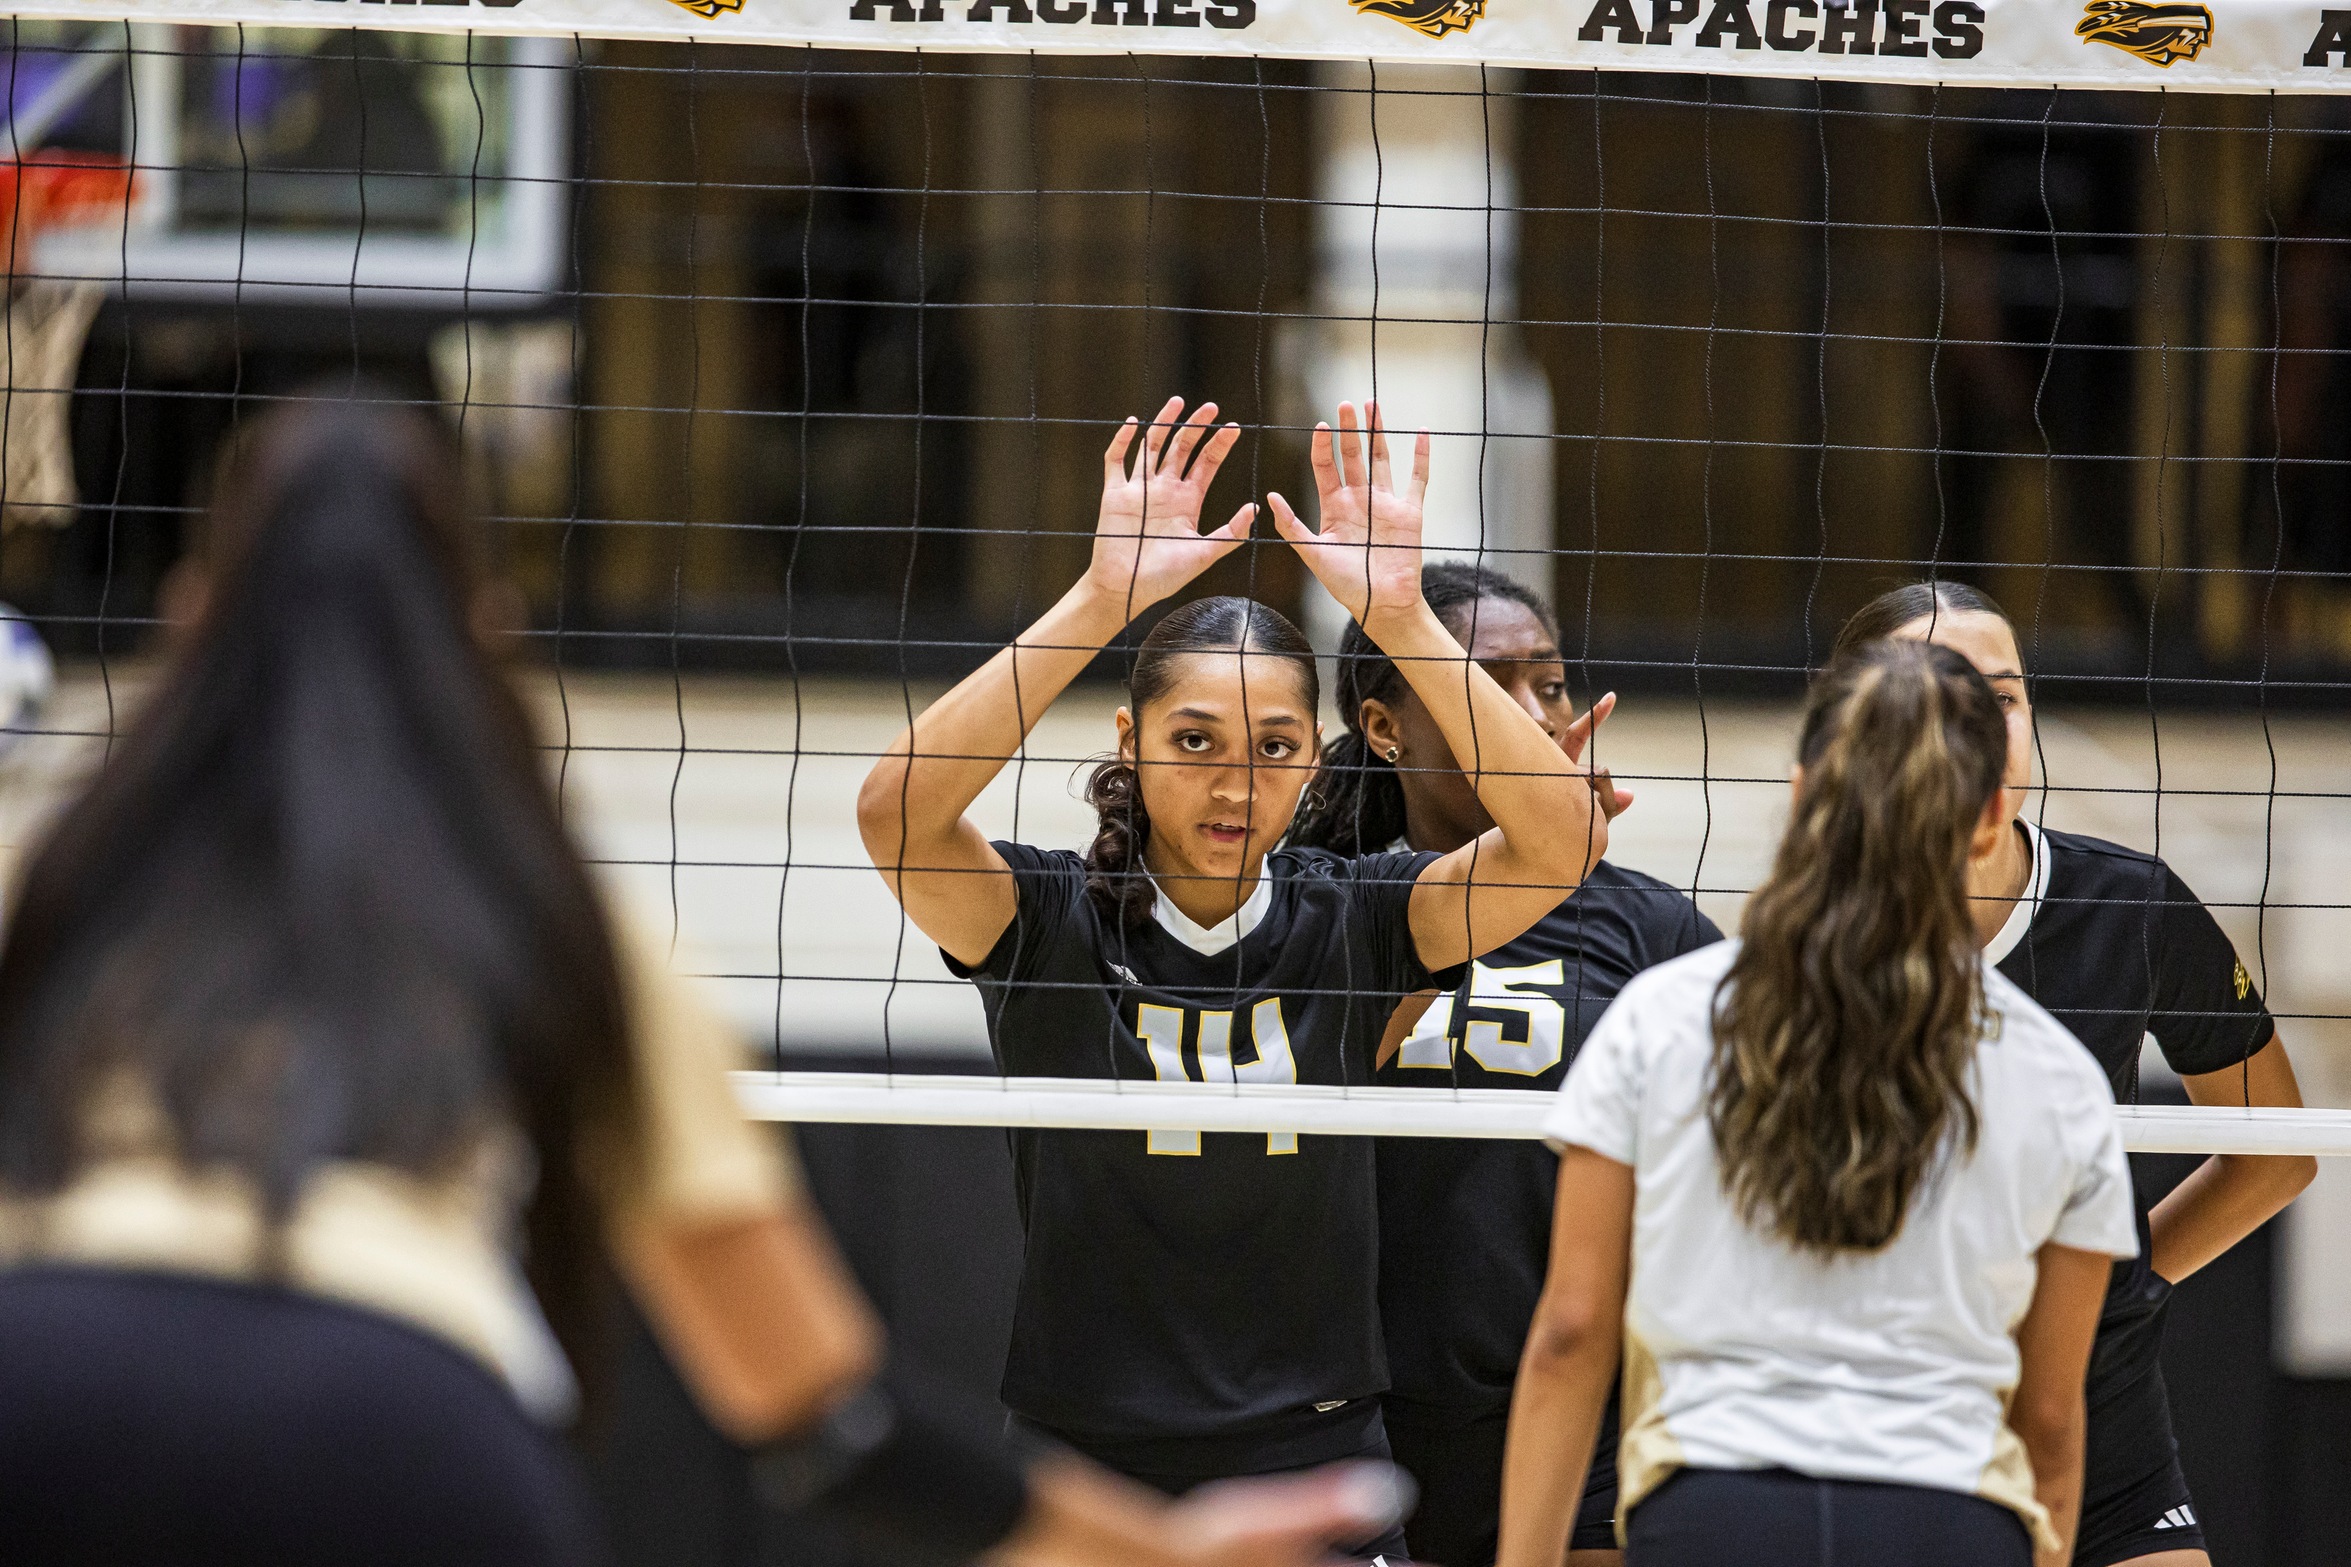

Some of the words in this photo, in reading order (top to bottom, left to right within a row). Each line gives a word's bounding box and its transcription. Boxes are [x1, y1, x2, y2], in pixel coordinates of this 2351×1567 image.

[1577, 0, 1986, 59] APACHES
[1136, 997, 1298, 1156] 14
[1397, 959, 1565, 1077] 15
